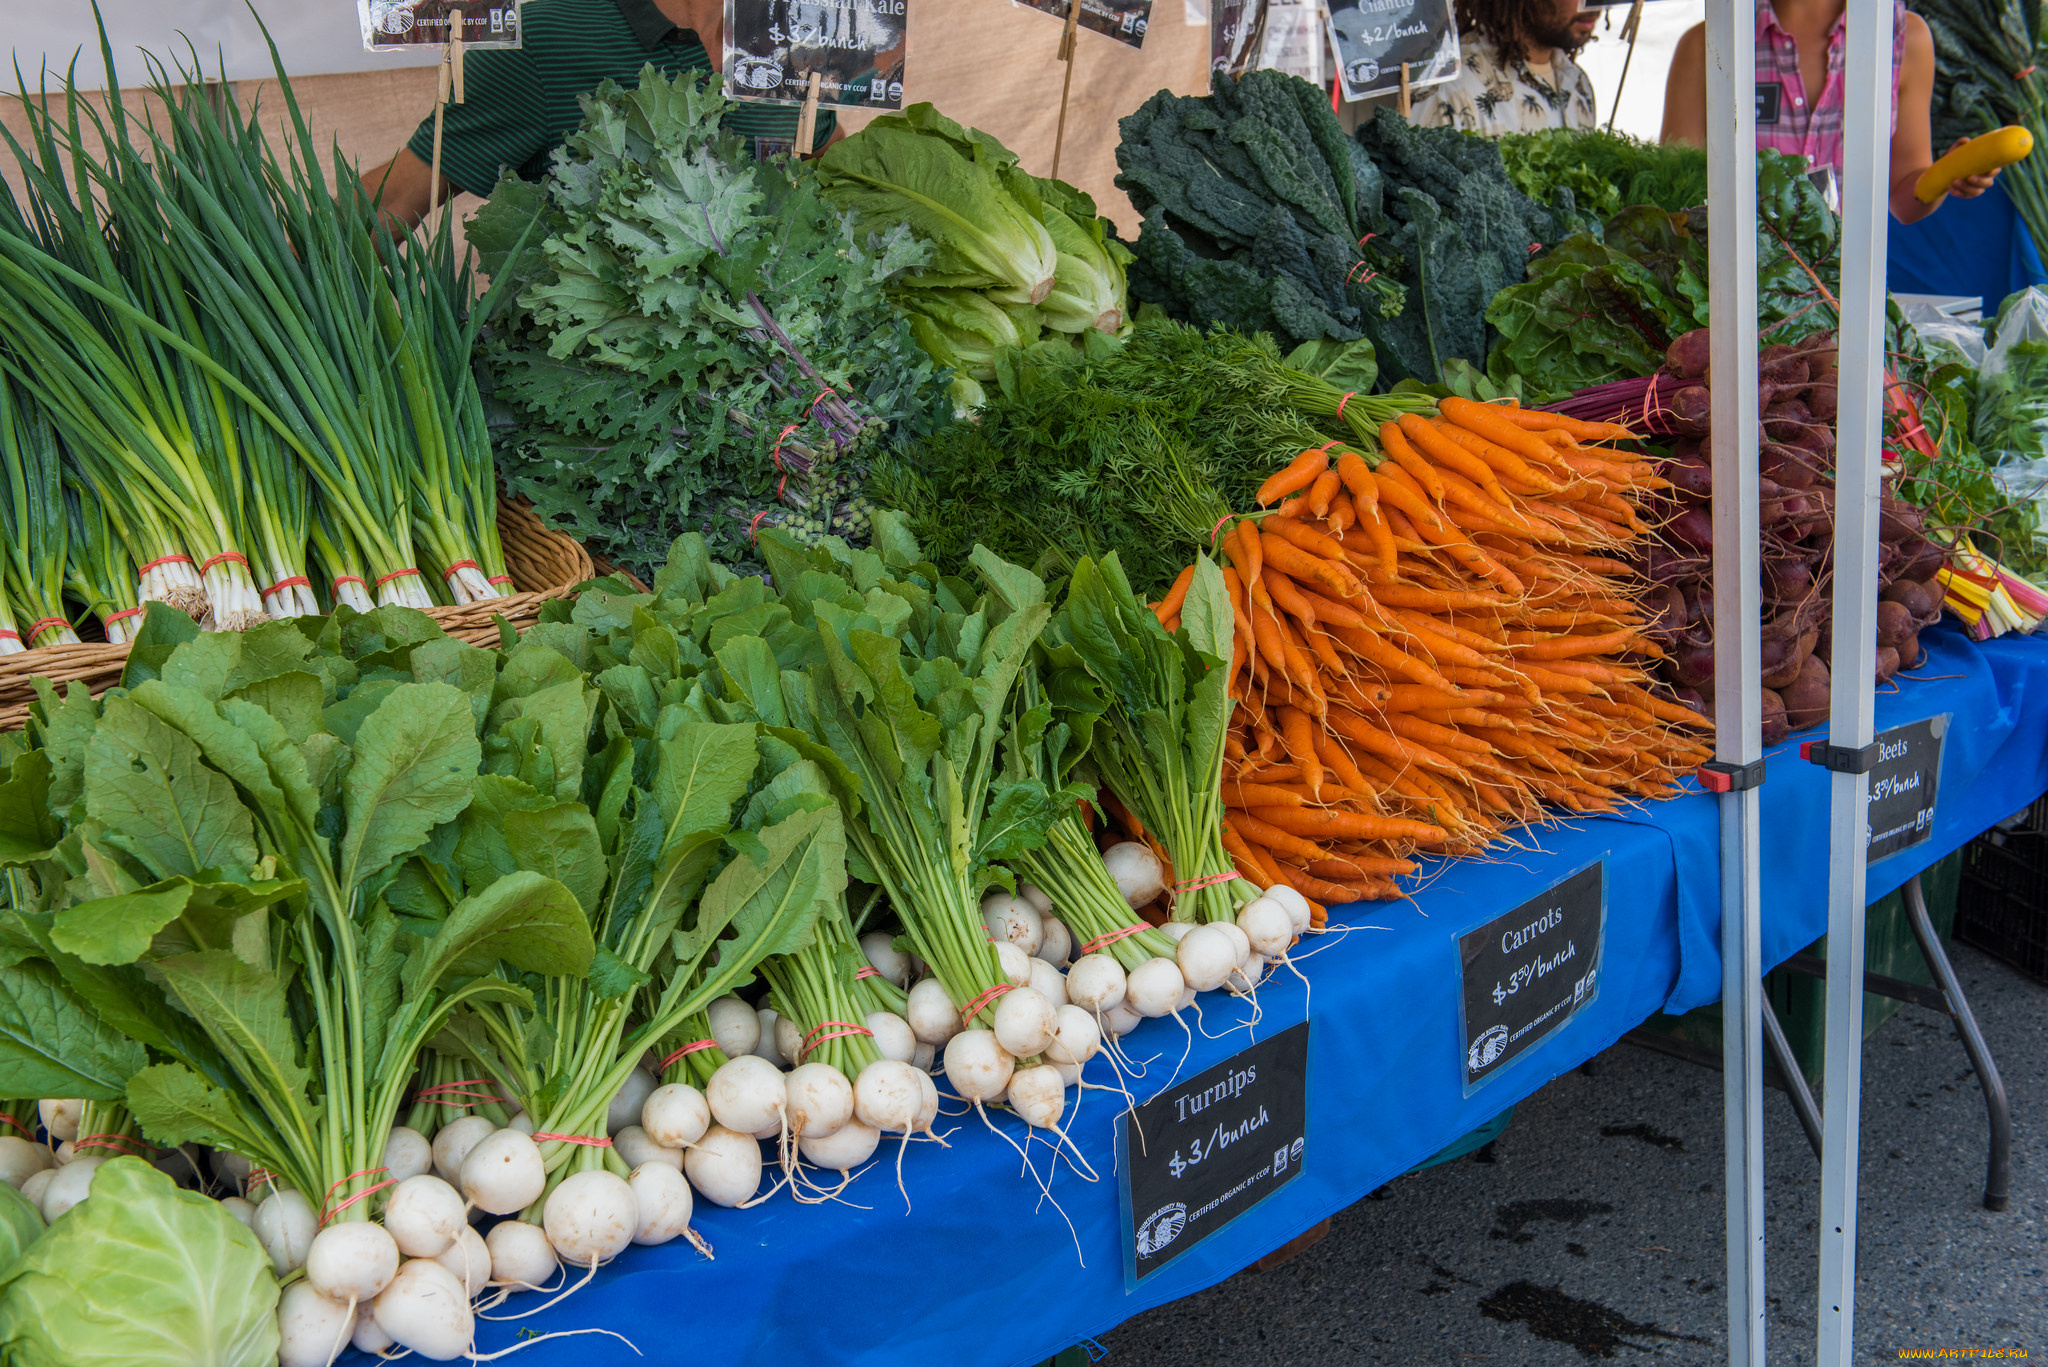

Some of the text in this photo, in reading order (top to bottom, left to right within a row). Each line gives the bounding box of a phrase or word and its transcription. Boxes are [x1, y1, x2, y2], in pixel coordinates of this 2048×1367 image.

[416, 19, 443, 27] CERTIFIED
[467, 18, 474, 26] BY
[475, 18, 488, 26] CCOF
[768, 22, 866, 51] $3/bunch
[1361, 20, 1428, 46] $2/bunch
[820, 81, 842, 90] RGANIC
[843, 83, 853, 91] BY
[1878, 738, 1908, 763] Beets
[1501, 906, 1562, 954] Carrots
[1510, 994, 1573, 1043] CERTIFIED ORGANIC BY CCOF
[1174, 1064, 1257, 1122] Turnips
[1168, 1104, 1270, 1179] $3/bunch
[1189, 1165, 1271, 1222] CERTIFIED ORGANIC BY CCOF
